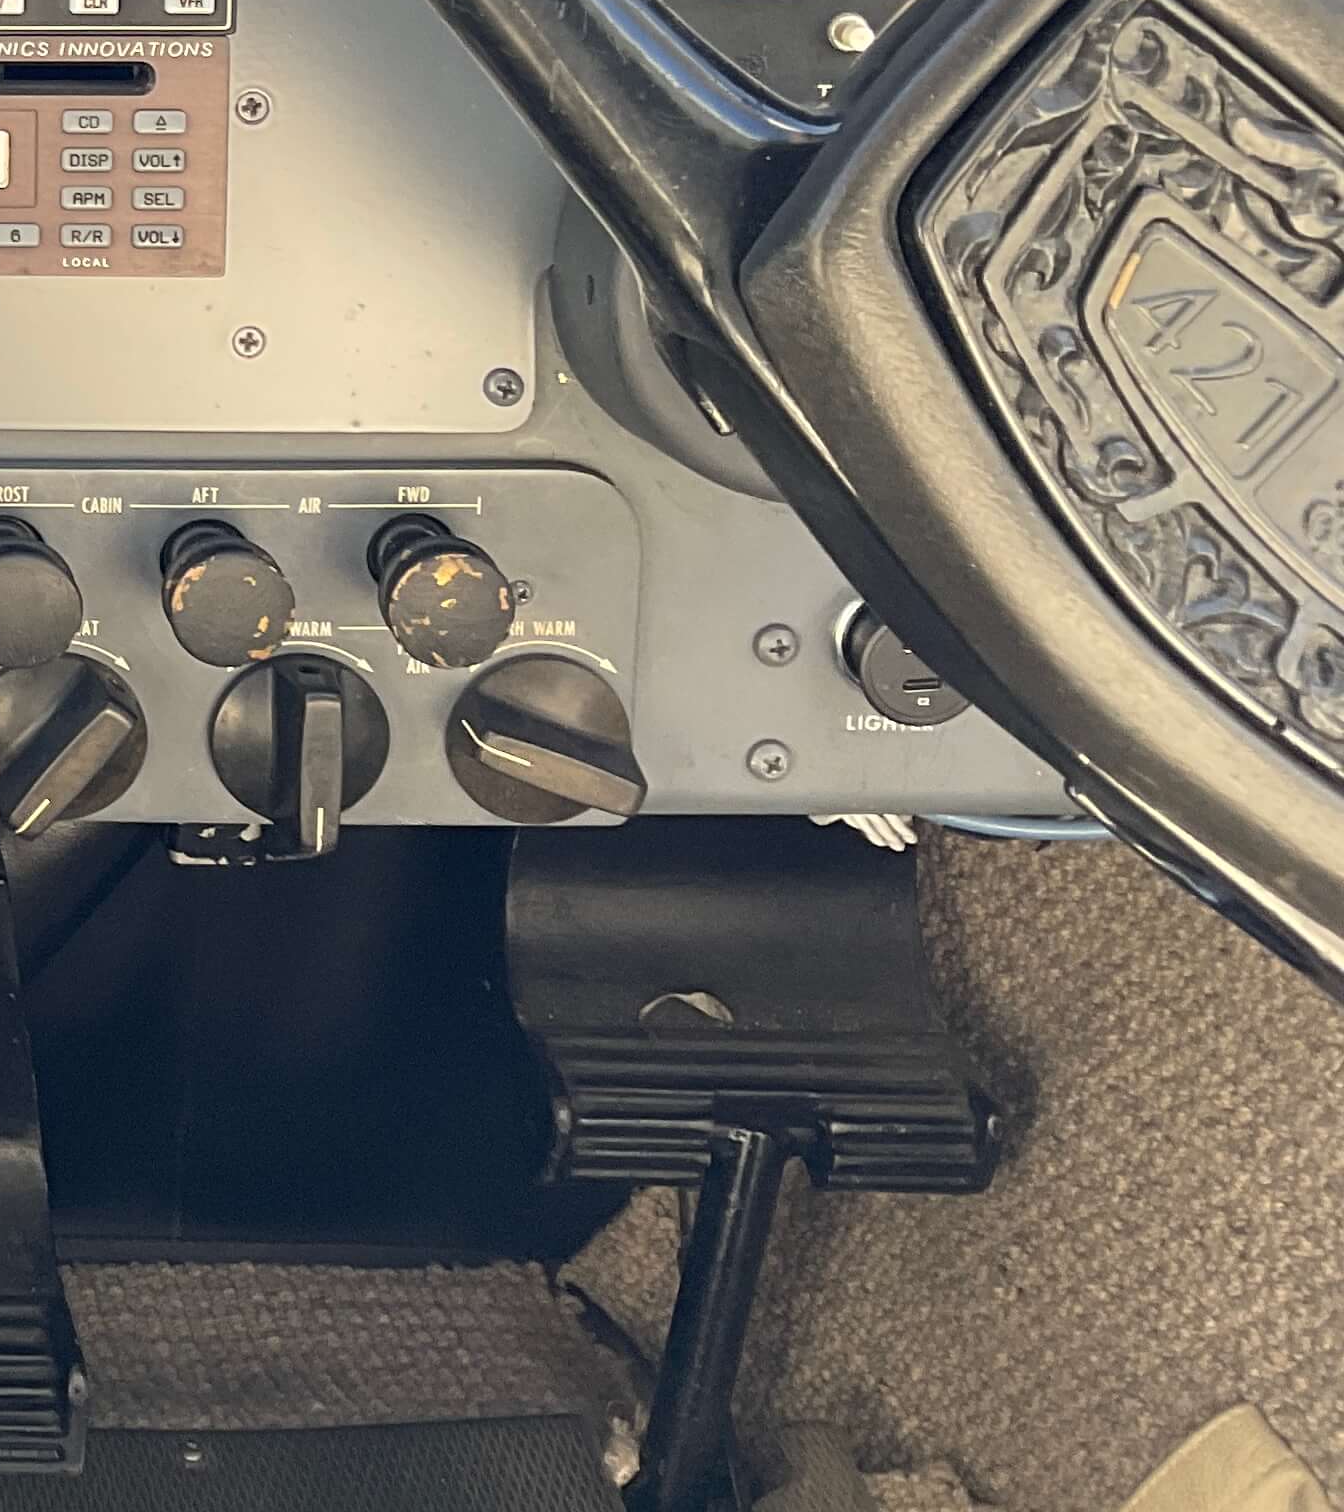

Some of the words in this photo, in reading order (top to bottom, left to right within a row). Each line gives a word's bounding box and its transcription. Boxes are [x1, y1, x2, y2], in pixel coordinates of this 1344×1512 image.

[59, 42, 213, 57] INNOVATIONS
[193, 487, 219, 503] AFT
[397, 486, 430, 503] FWD
[82, 497, 122, 514] CABIN
[299, 497, 321, 514] AIR
